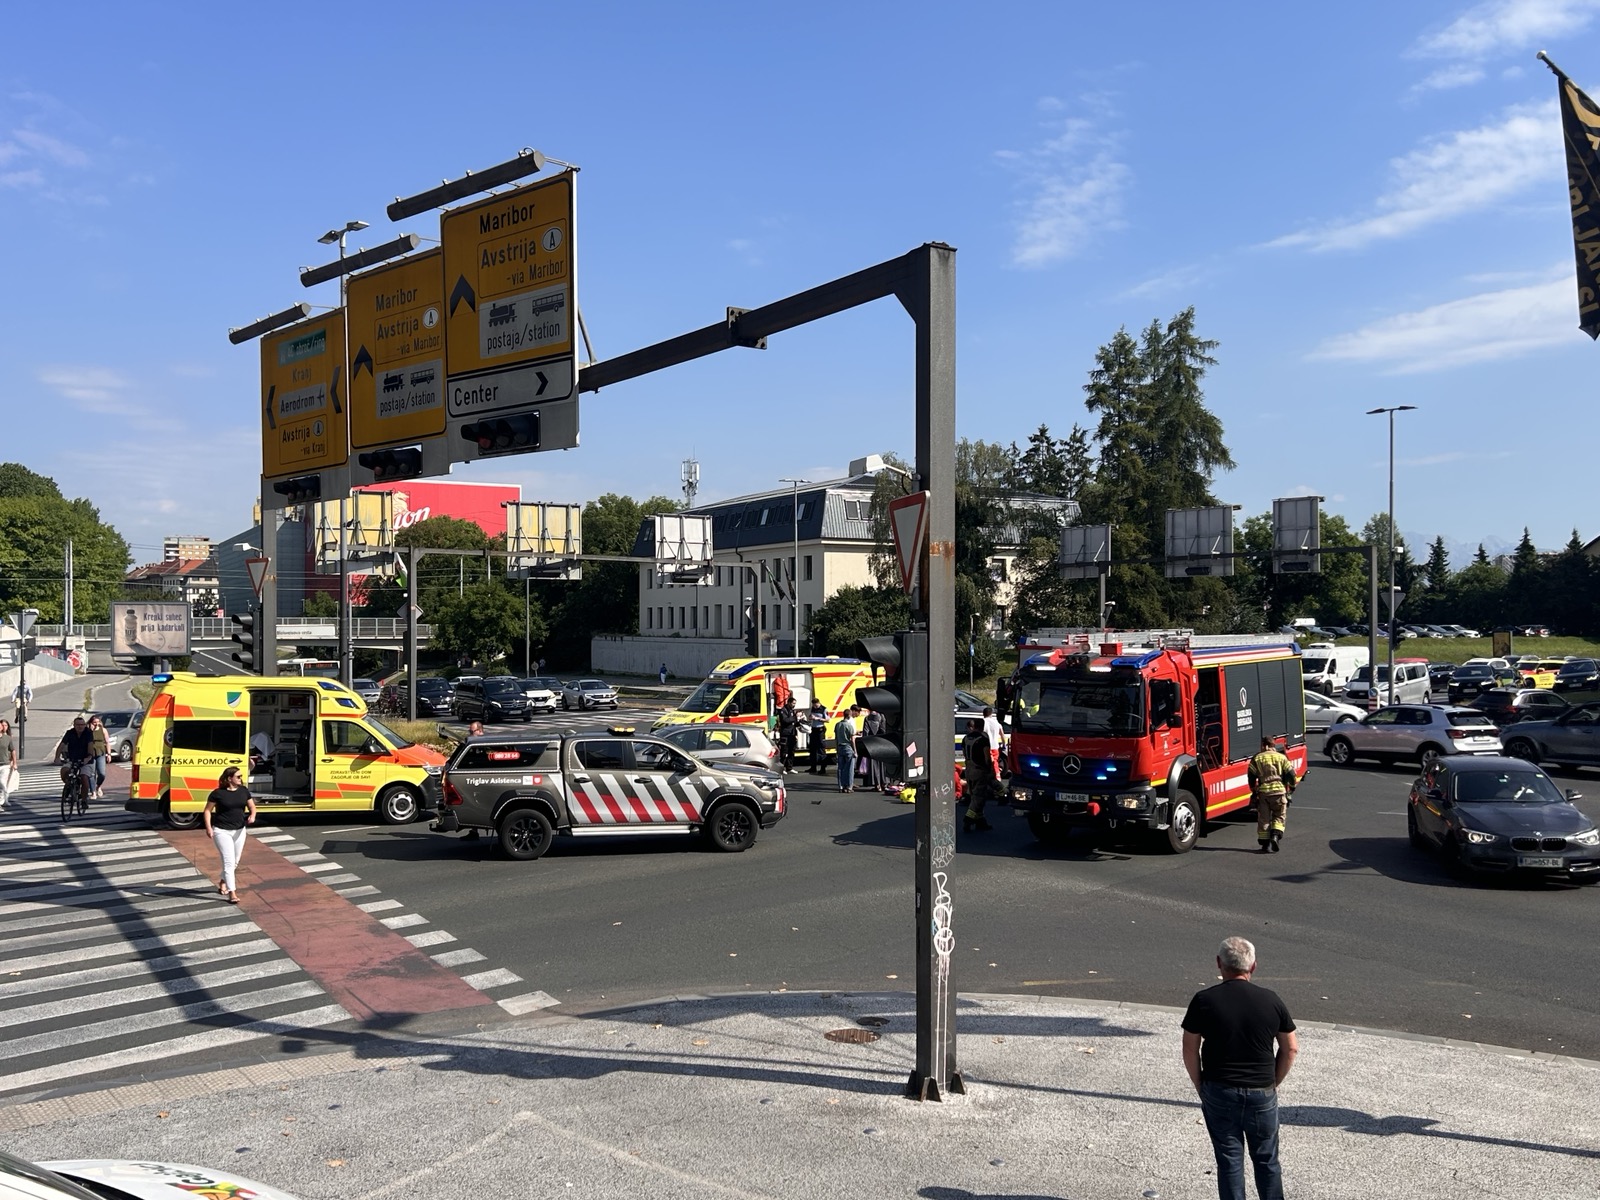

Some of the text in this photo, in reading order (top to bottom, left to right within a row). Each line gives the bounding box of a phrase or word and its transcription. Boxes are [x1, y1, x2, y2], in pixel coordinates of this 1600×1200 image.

[480, 204, 535, 234] Maribor
[481, 239, 536, 269] Avstrija
[529, 259, 564, 280] Maribor
[376, 288, 418, 312] Maribor
[377, 316, 418, 341] Avstrija
[487, 322, 560, 354] postaja/station
[414, 335, 440, 352] Maribor
[292, 367, 312, 383] Kranj
[280, 394, 315, 414] Aerodrom
[380, 391, 436, 416] postaja/station
[454, 384, 499, 407] Center
[282, 424, 310, 443] Avstrija
[312, 442, 326, 455] Kranj
[466, 778, 489, 786] Triglav
